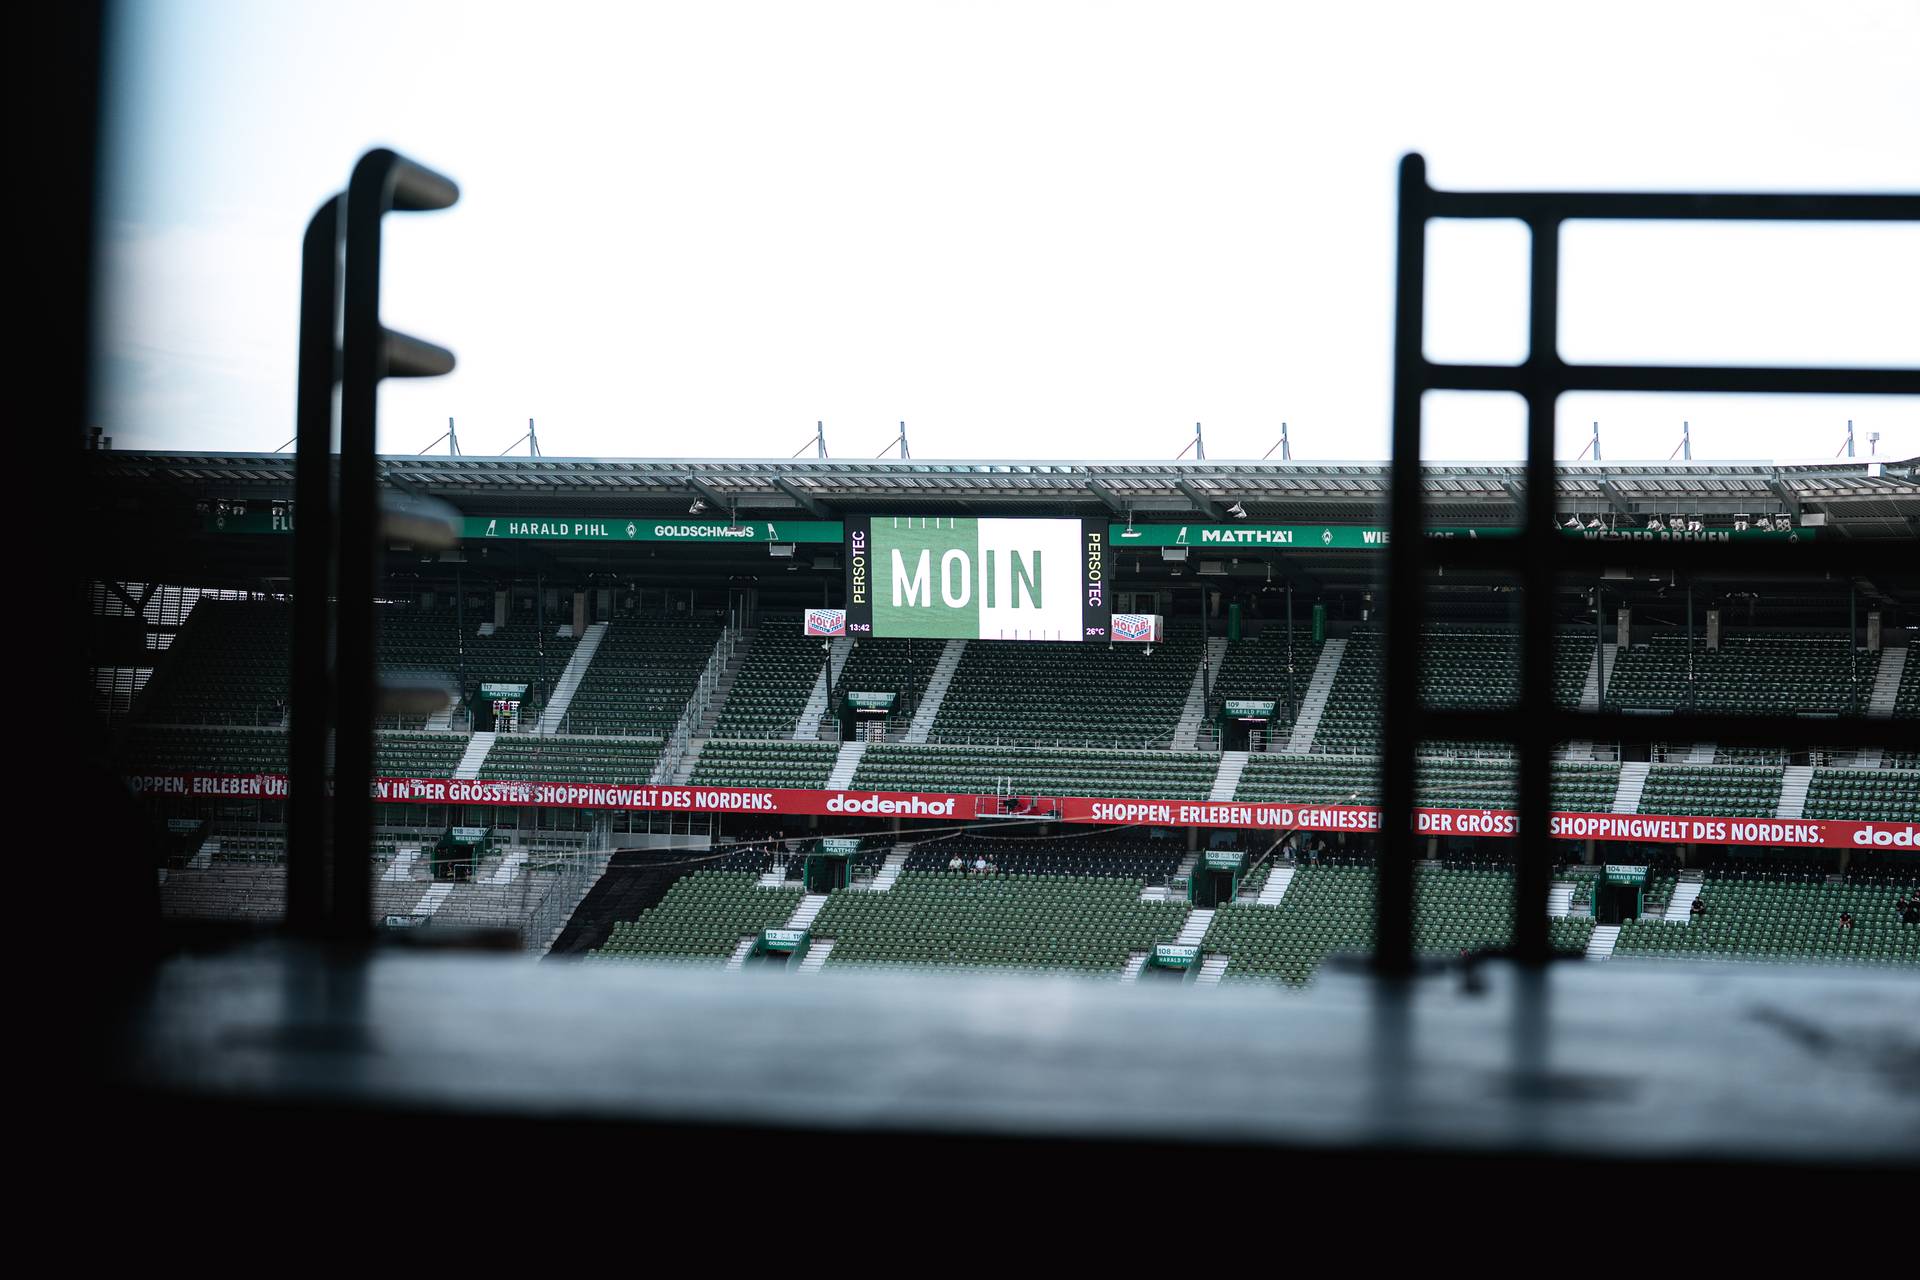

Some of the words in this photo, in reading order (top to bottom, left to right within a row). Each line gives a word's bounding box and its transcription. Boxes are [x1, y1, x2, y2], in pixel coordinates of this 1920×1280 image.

[509, 522, 569, 535] HARALD
[574, 523, 609, 536] PIHL
[1202, 530, 1293, 543] MATTHÄI
[852, 530, 866, 604] PERSOTEC
[891, 548, 1042, 609] MOIN
[1088, 533, 1102, 607] PERSOTEC
[849, 624, 870, 632] 13:42
[193, 777, 260, 795] ERLEBEN
[265, 779, 288, 796] UN
[393, 782, 410, 799] IN
[533, 785, 658, 807] SHOPPINGWELT
[661, 790, 691, 808] DES
[695, 791, 777, 810] NORDENS.
[826, 794, 955, 815] dodenhof
[1091, 802, 1176, 825] SHOPPEN,
[1180, 805, 1252, 825] ERLEBEN
[1257, 808, 1294, 826] UND
[1418, 813, 1452, 831] DER
[1456, 810, 1521, 833] GRÖSST
[1550, 816, 1689, 839] SHOPPINGWELT
[1693, 821, 1726, 840] DES
[1731, 823, 1825, 843] NORDENS.
